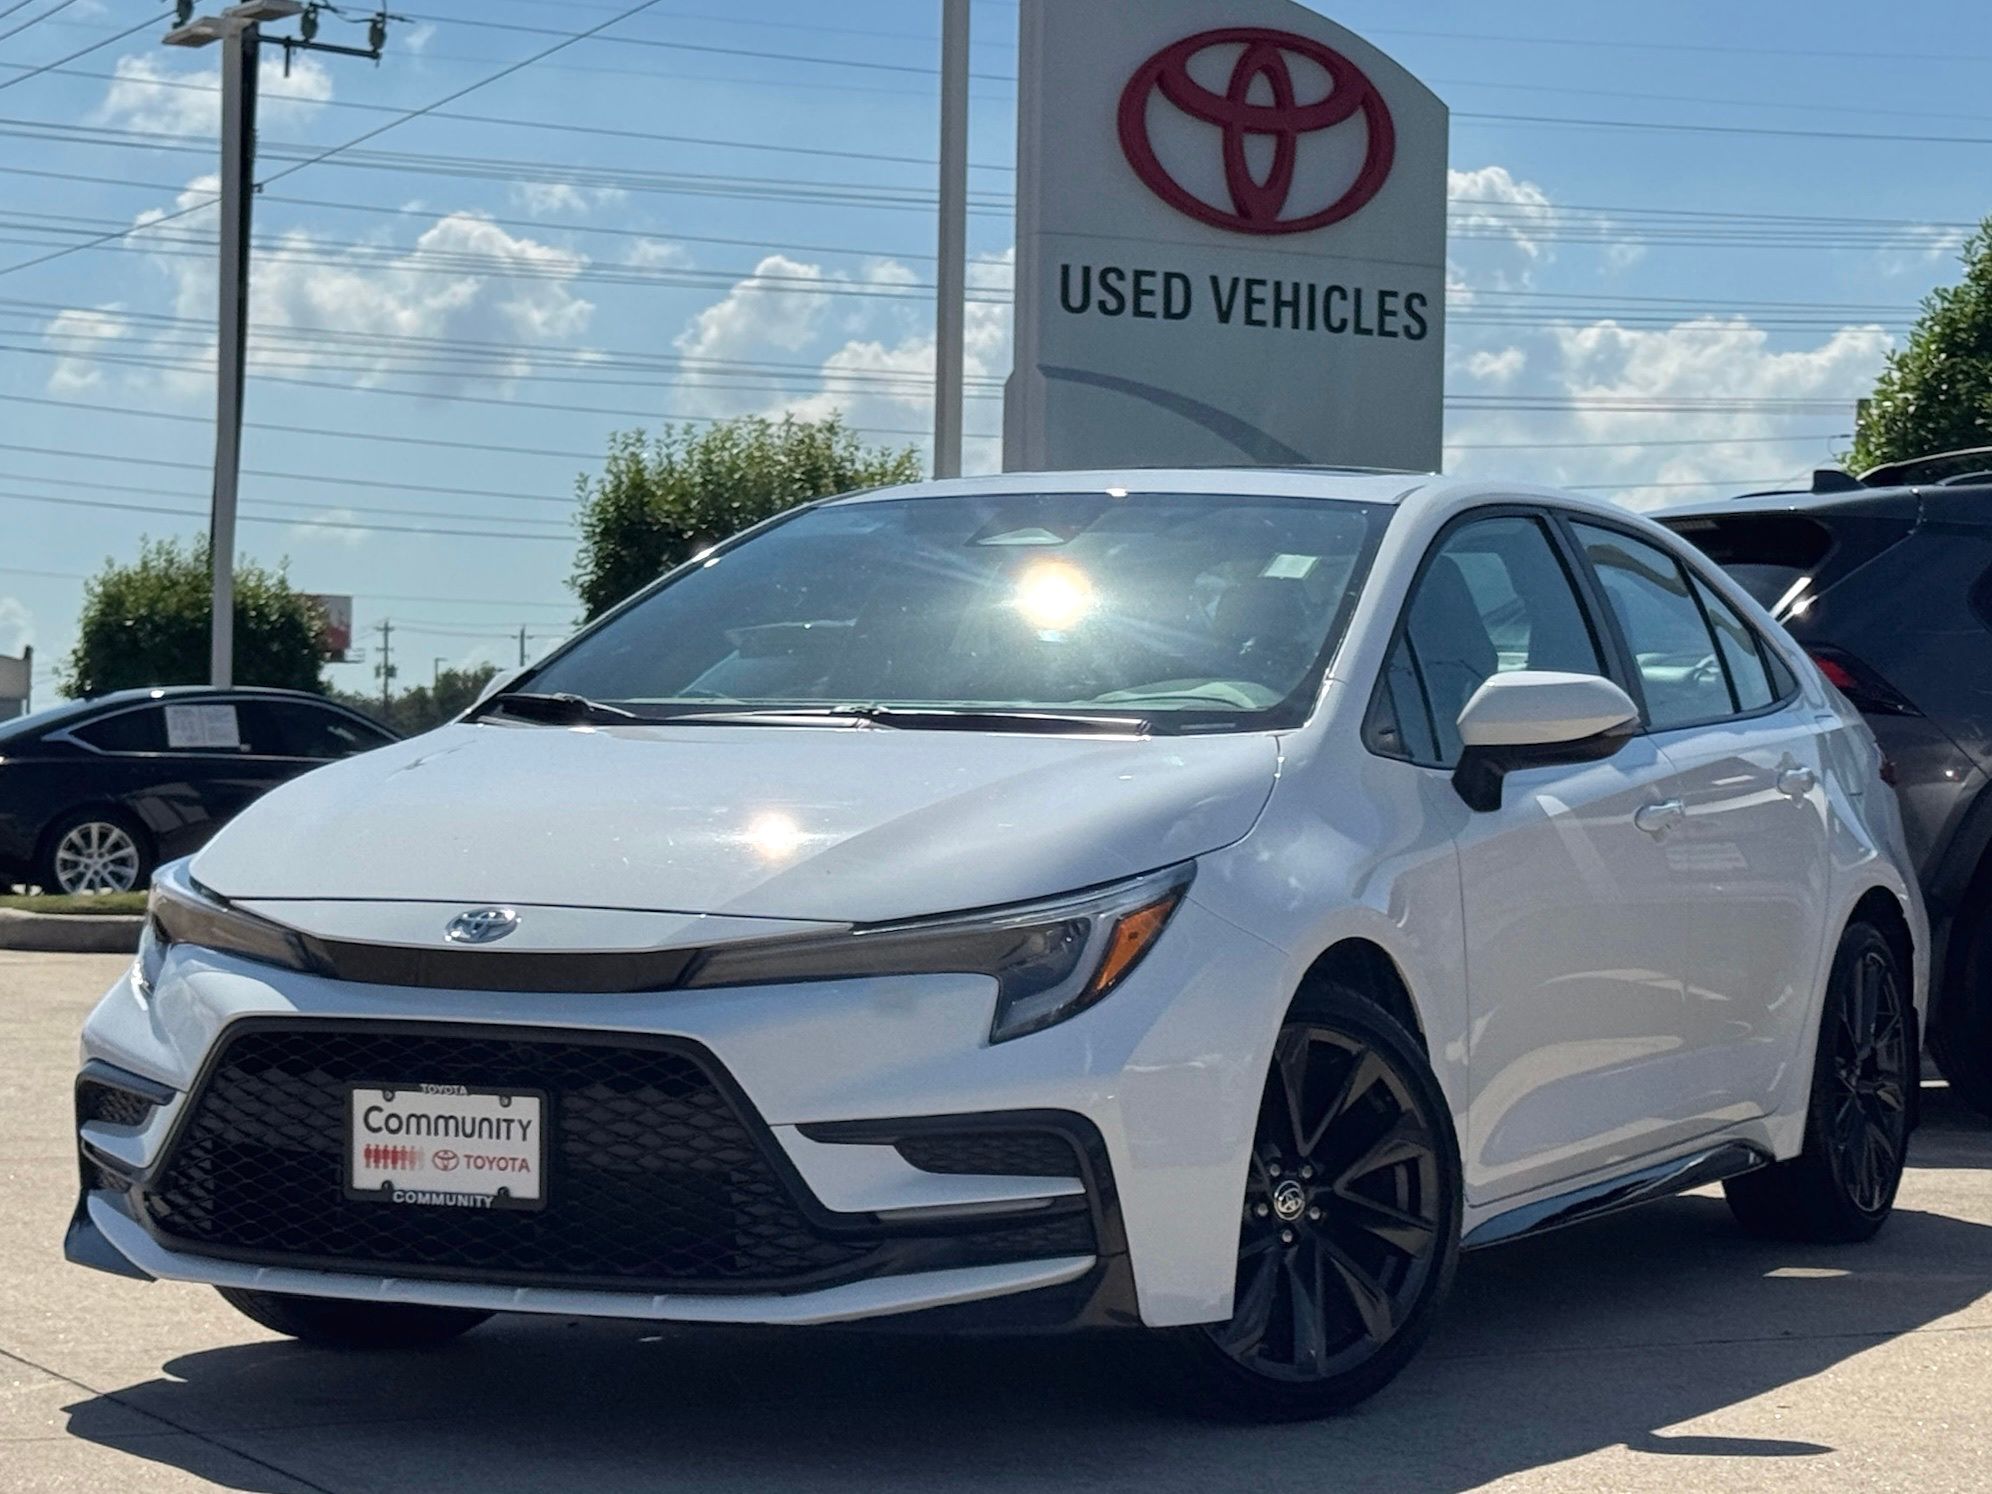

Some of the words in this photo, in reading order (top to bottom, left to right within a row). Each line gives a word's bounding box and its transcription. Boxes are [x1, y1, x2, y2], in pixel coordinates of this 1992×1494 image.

[1060, 263, 1192, 320] USED
[1209, 274, 1428, 341] VEHICLES
[420, 1084, 468, 1096] TOYOTA
[463, 1154, 531, 1173] TOYOTA
[393, 1190, 495, 1209] COMMUNITY
